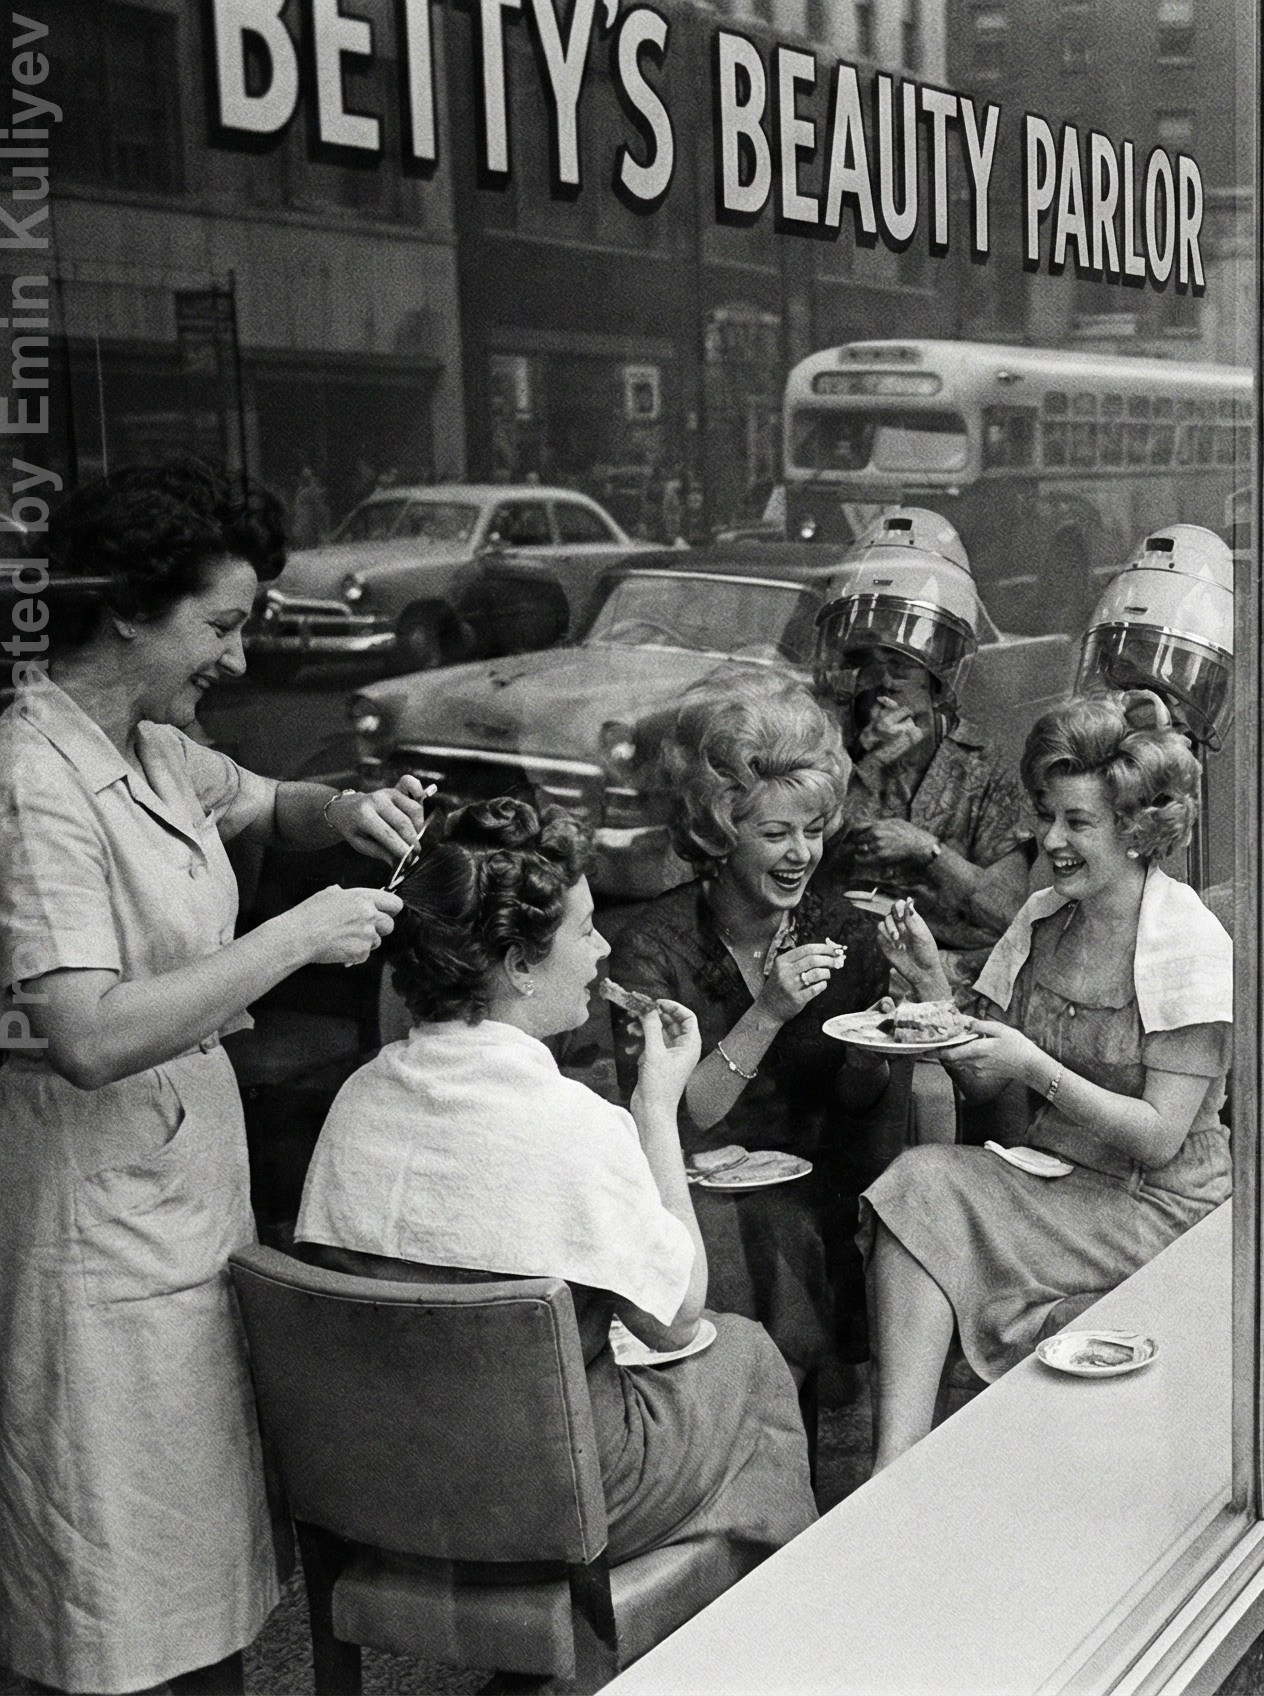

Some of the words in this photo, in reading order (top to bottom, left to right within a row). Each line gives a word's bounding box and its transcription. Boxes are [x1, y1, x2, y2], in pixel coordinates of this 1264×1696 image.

[212, 0, 675, 201] BETTY'S
[717, 31, 1001, 253] BEAUTY
[1026, 114, 1206, 287] PARLOR
